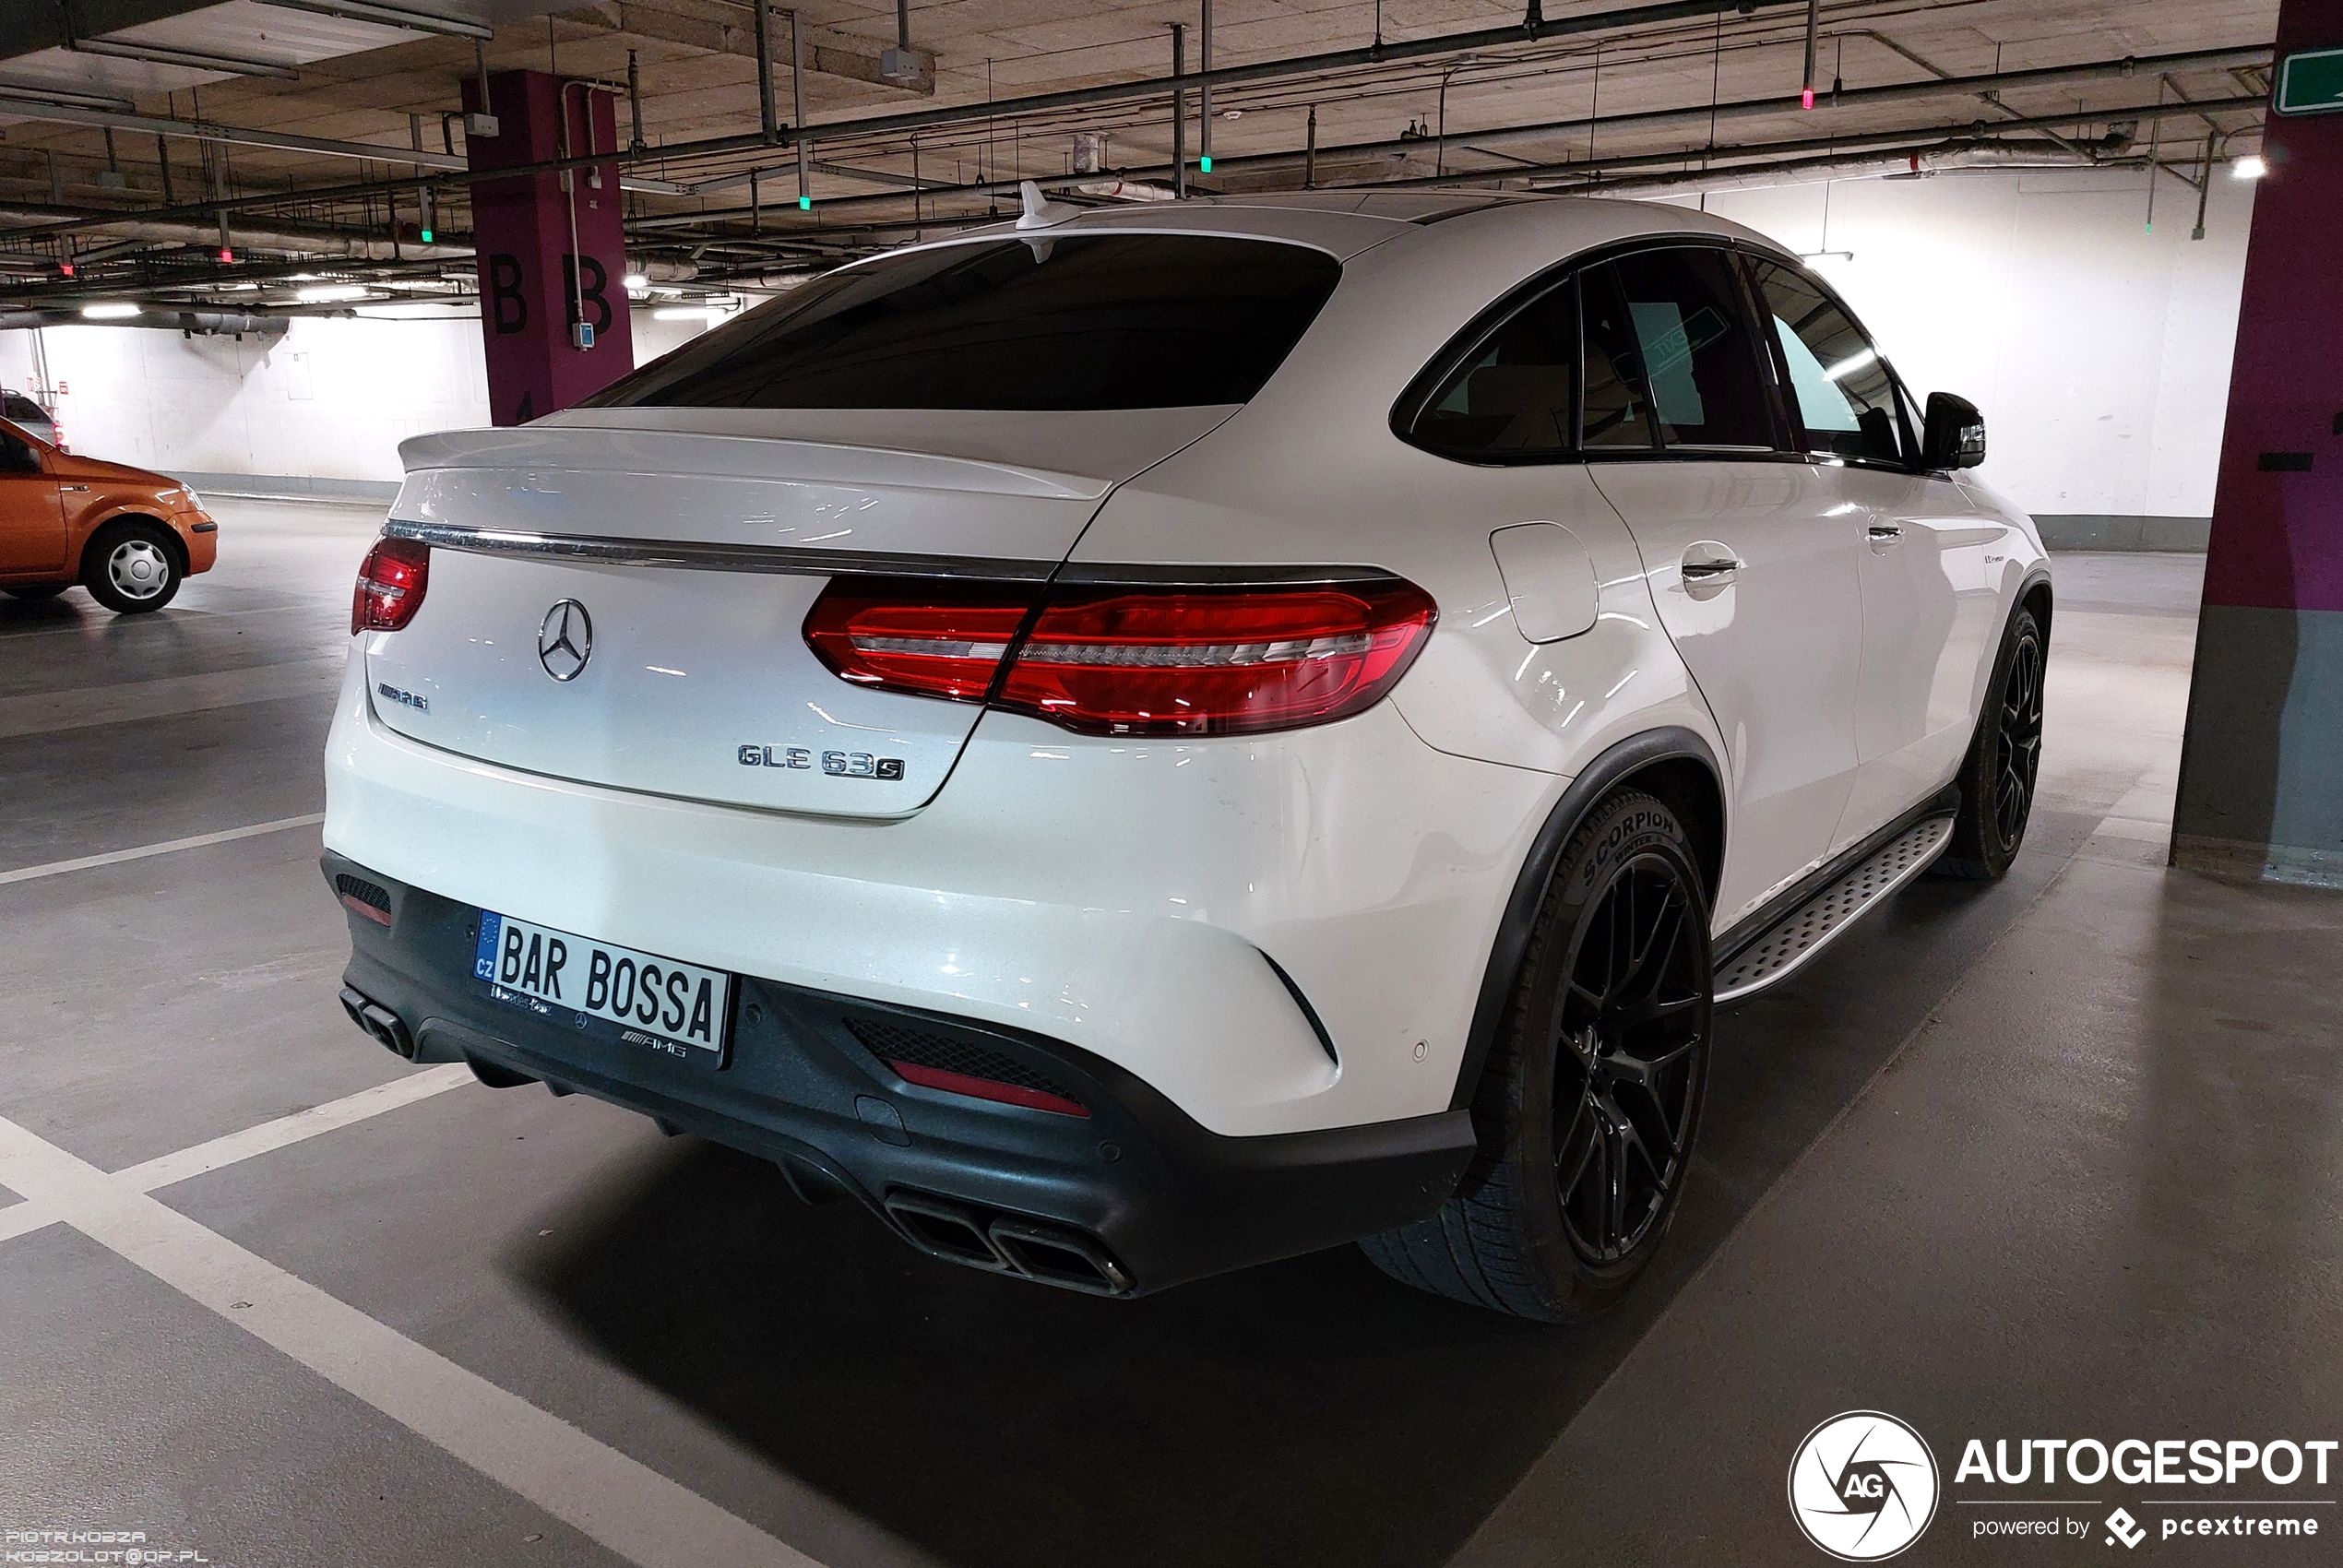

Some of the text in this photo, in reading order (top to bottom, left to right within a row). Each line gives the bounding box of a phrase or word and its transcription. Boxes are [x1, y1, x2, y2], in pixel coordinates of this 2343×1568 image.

[490, 254, 527, 334] B
[562, 254, 612, 336] B
[738, 744, 812, 769] GLE
[1584, 811, 1674, 886] SCORPION
[476, 957, 494, 979] CZ
[501, 925, 712, 1043] BAR BOSSA
